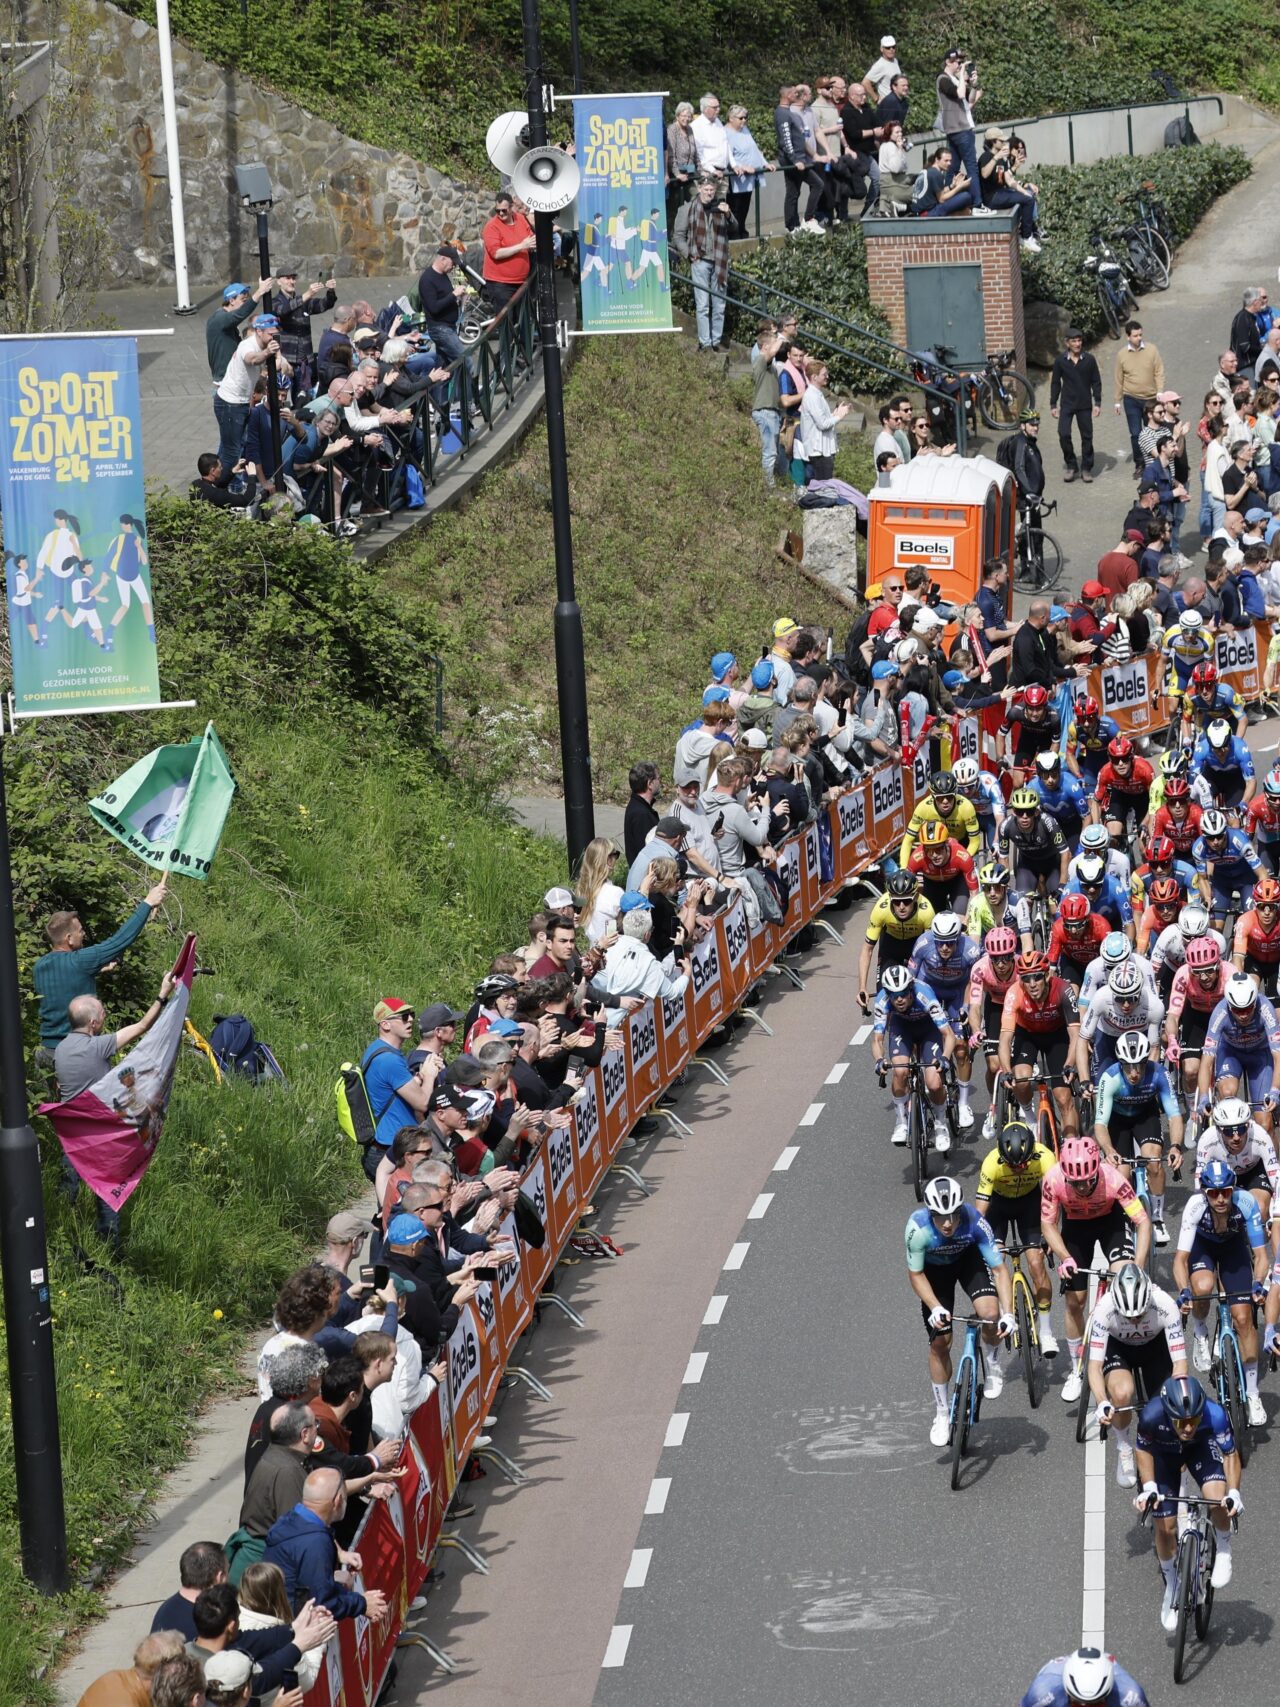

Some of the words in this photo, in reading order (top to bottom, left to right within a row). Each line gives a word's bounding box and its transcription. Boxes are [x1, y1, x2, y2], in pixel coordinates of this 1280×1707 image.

[589, 115, 650, 147] SPORT
[583, 144, 658, 176] ZOMER
[611, 170, 632, 188] 24
[526, 193, 571, 210] BOCHOLTZ
[18, 366, 118, 418] SPORT
[10, 413, 133, 464] ZOMER
[9, 466, 51, 474] VALKENBURG
[55, 453, 90, 483] 24
[95, 469, 133, 478] SEPTEMBER
[900, 541, 949, 554] Boels
[1218, 635, 1256, 670] Boels
[42, 678, 87, 688] GEZONDER
[89, 675, 129, 685] BEWEGEN
[57, 668, 87, 677] SAMEN
[88, 665, 113, 674] VOOR
[23, 686, 152, 702] SPORTZOMERVALKENBURG.NL
[1103, 670, 1147, 706] Boels
[873, 770, 903, 816] Boels
[838, 796, 865, 840] Boels
[127, 834, 165, 862] WITH
[169, 848, 192, 866] ON
[1064, 986, 1079, 1014] INEOS
[1107, 1011, 1148, 1025] BAHRAIN
[632, 1010, 656, 1066] Boels
[603, 1049, 625, 1107] Boels
[576, 1086, 597, 1149] Boels
[550, 1128, 572, 1192] Boels
[1115, 1183, 1135, 1201] EF
[1118, 1330, 1154, 1339] UAE
